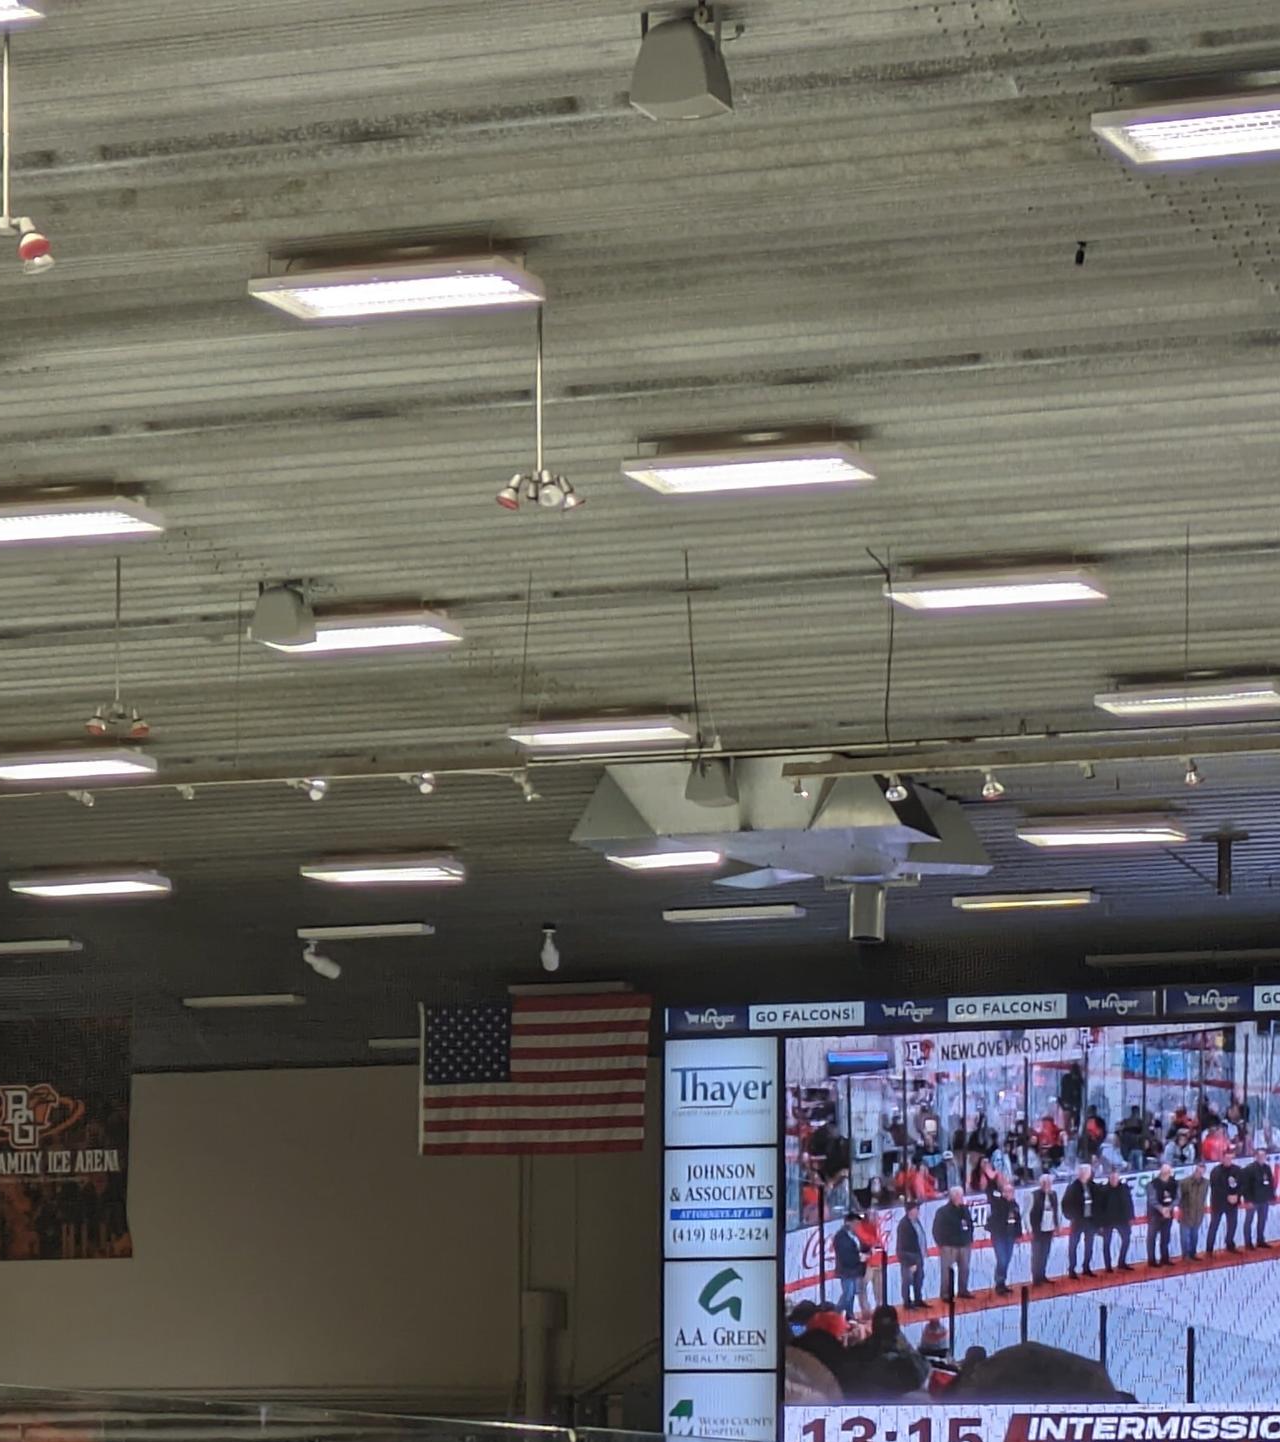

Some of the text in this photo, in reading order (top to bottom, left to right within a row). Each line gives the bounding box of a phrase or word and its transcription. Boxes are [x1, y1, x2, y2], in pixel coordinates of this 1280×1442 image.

[755, 1008, 856, 1023] GO FALCONS!
[954, 1001, 1057, 1016] GO FALCONS!
[941, 1041, 1003, 1061] NEWLOVE
[1034, 1034, 1068, 1052] SHOP
[671, 1066, 773, 1109] Thayer
[47, 1150, 70, 1173] ICE
[687, 1164, 756, 1182] JOHNSON
[671, 1185, 774, 1201] & ASSOCIATES
[672, 1226, 769, 1244] (419) 843-2424
[674, 1326, 767, 1347] A.A. GREEN
